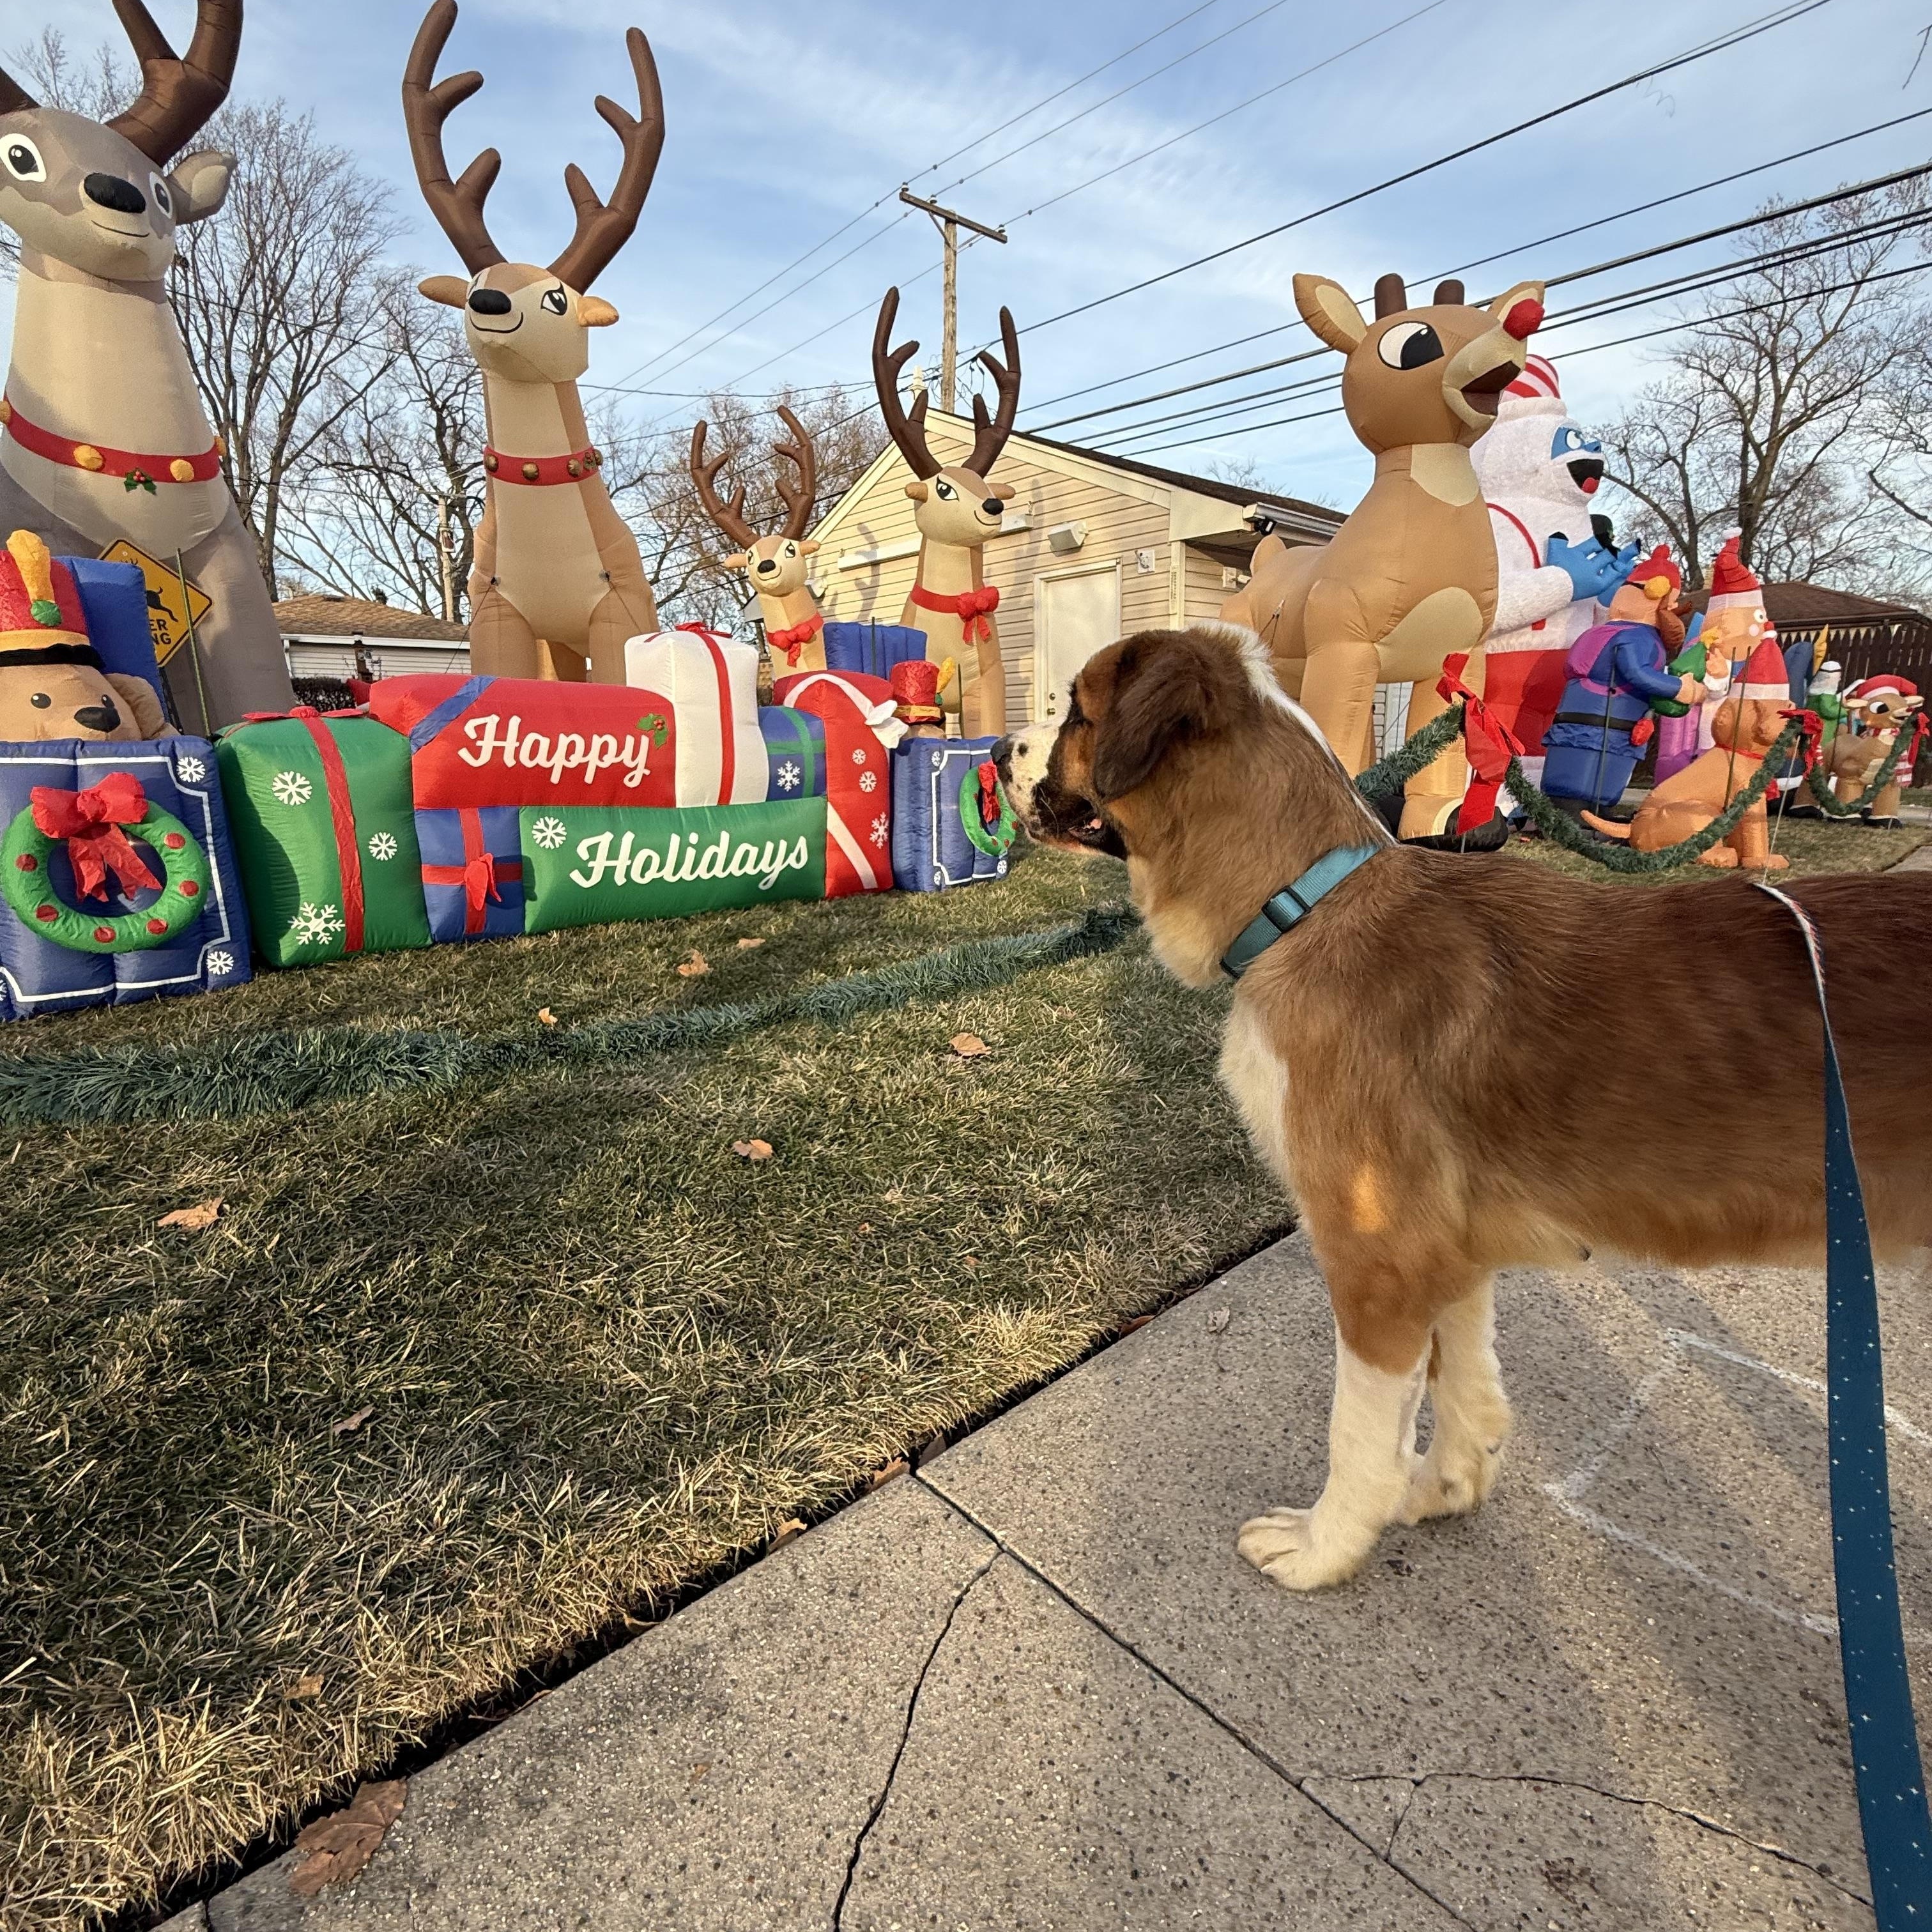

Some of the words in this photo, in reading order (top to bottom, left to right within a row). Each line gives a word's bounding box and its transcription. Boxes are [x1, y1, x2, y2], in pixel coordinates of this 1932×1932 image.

[149, 619, 168, 631] ER
[457, 714, 650, 788] Happy
[569, 831, 808, 890] Holidays
